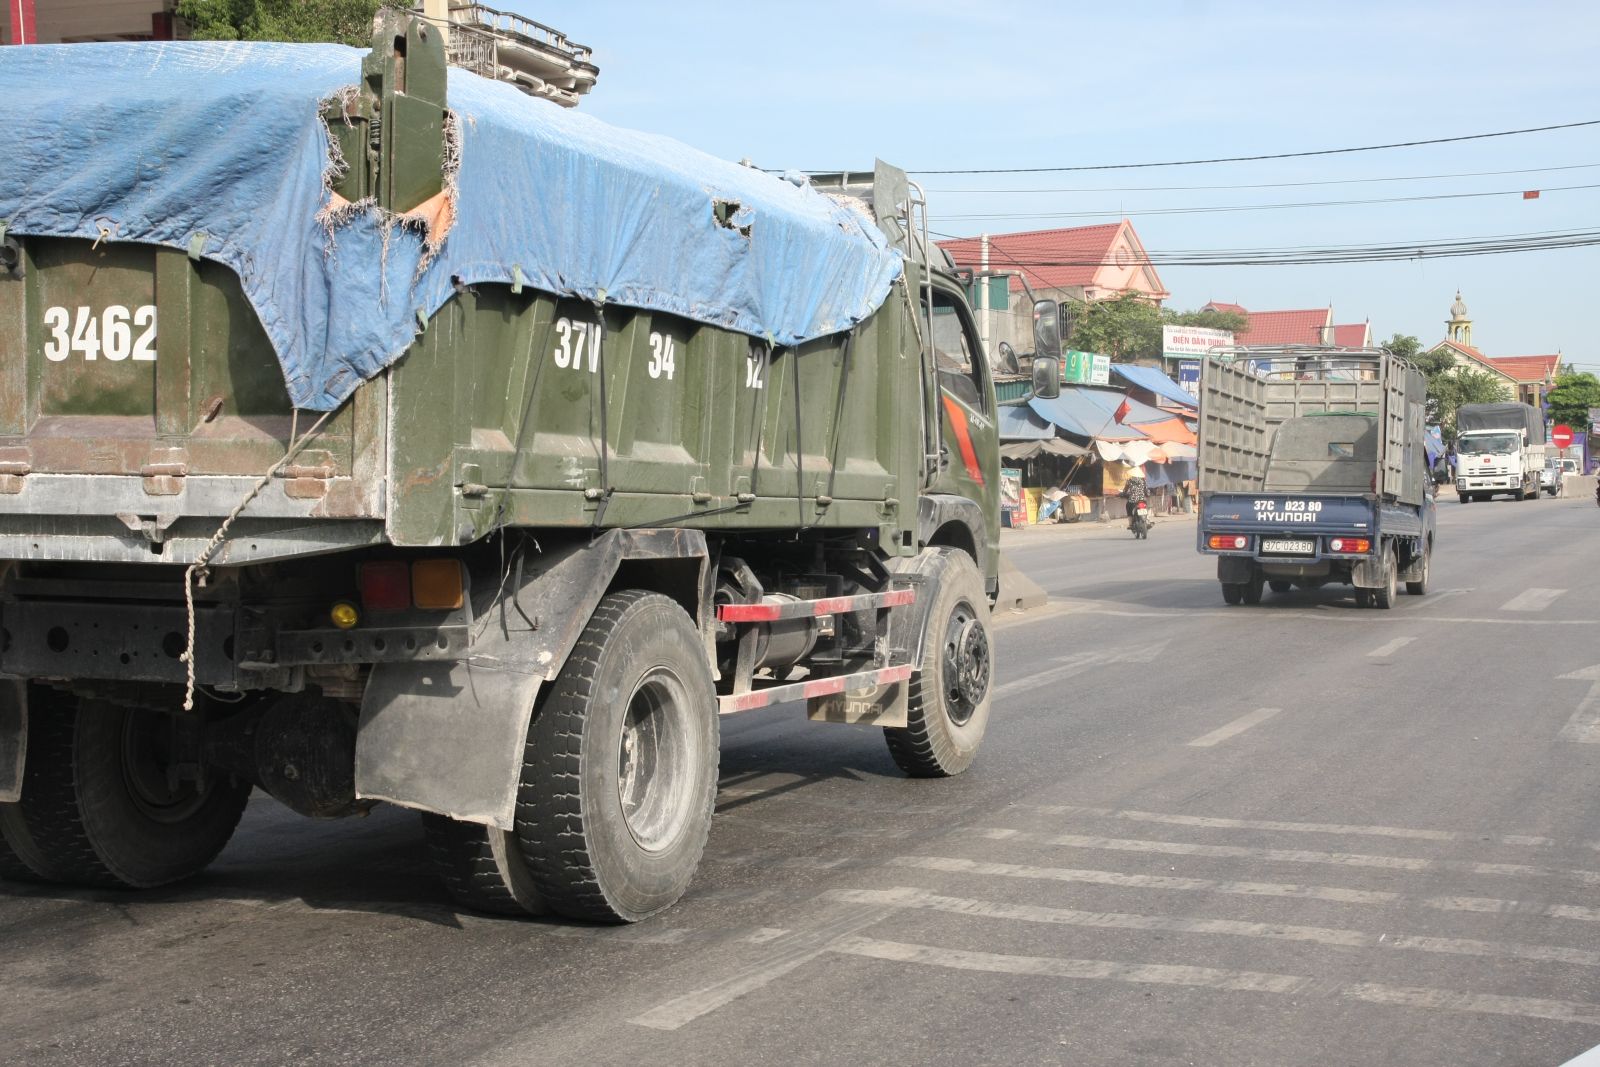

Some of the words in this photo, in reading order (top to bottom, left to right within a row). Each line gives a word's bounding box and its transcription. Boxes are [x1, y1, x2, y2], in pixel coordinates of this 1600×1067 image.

[44, 305, 157, 361] 3462
[648, 331, 675, 380] 34
[1254, 500, 1275, 511] 37C
[1284, 501, 1305, 511] 023
[1307, 501, 1322, 512] 80
[1257, 511, 1316, 522] HYUNDAI
[826, 700, 883, 715] HYUNDAI
